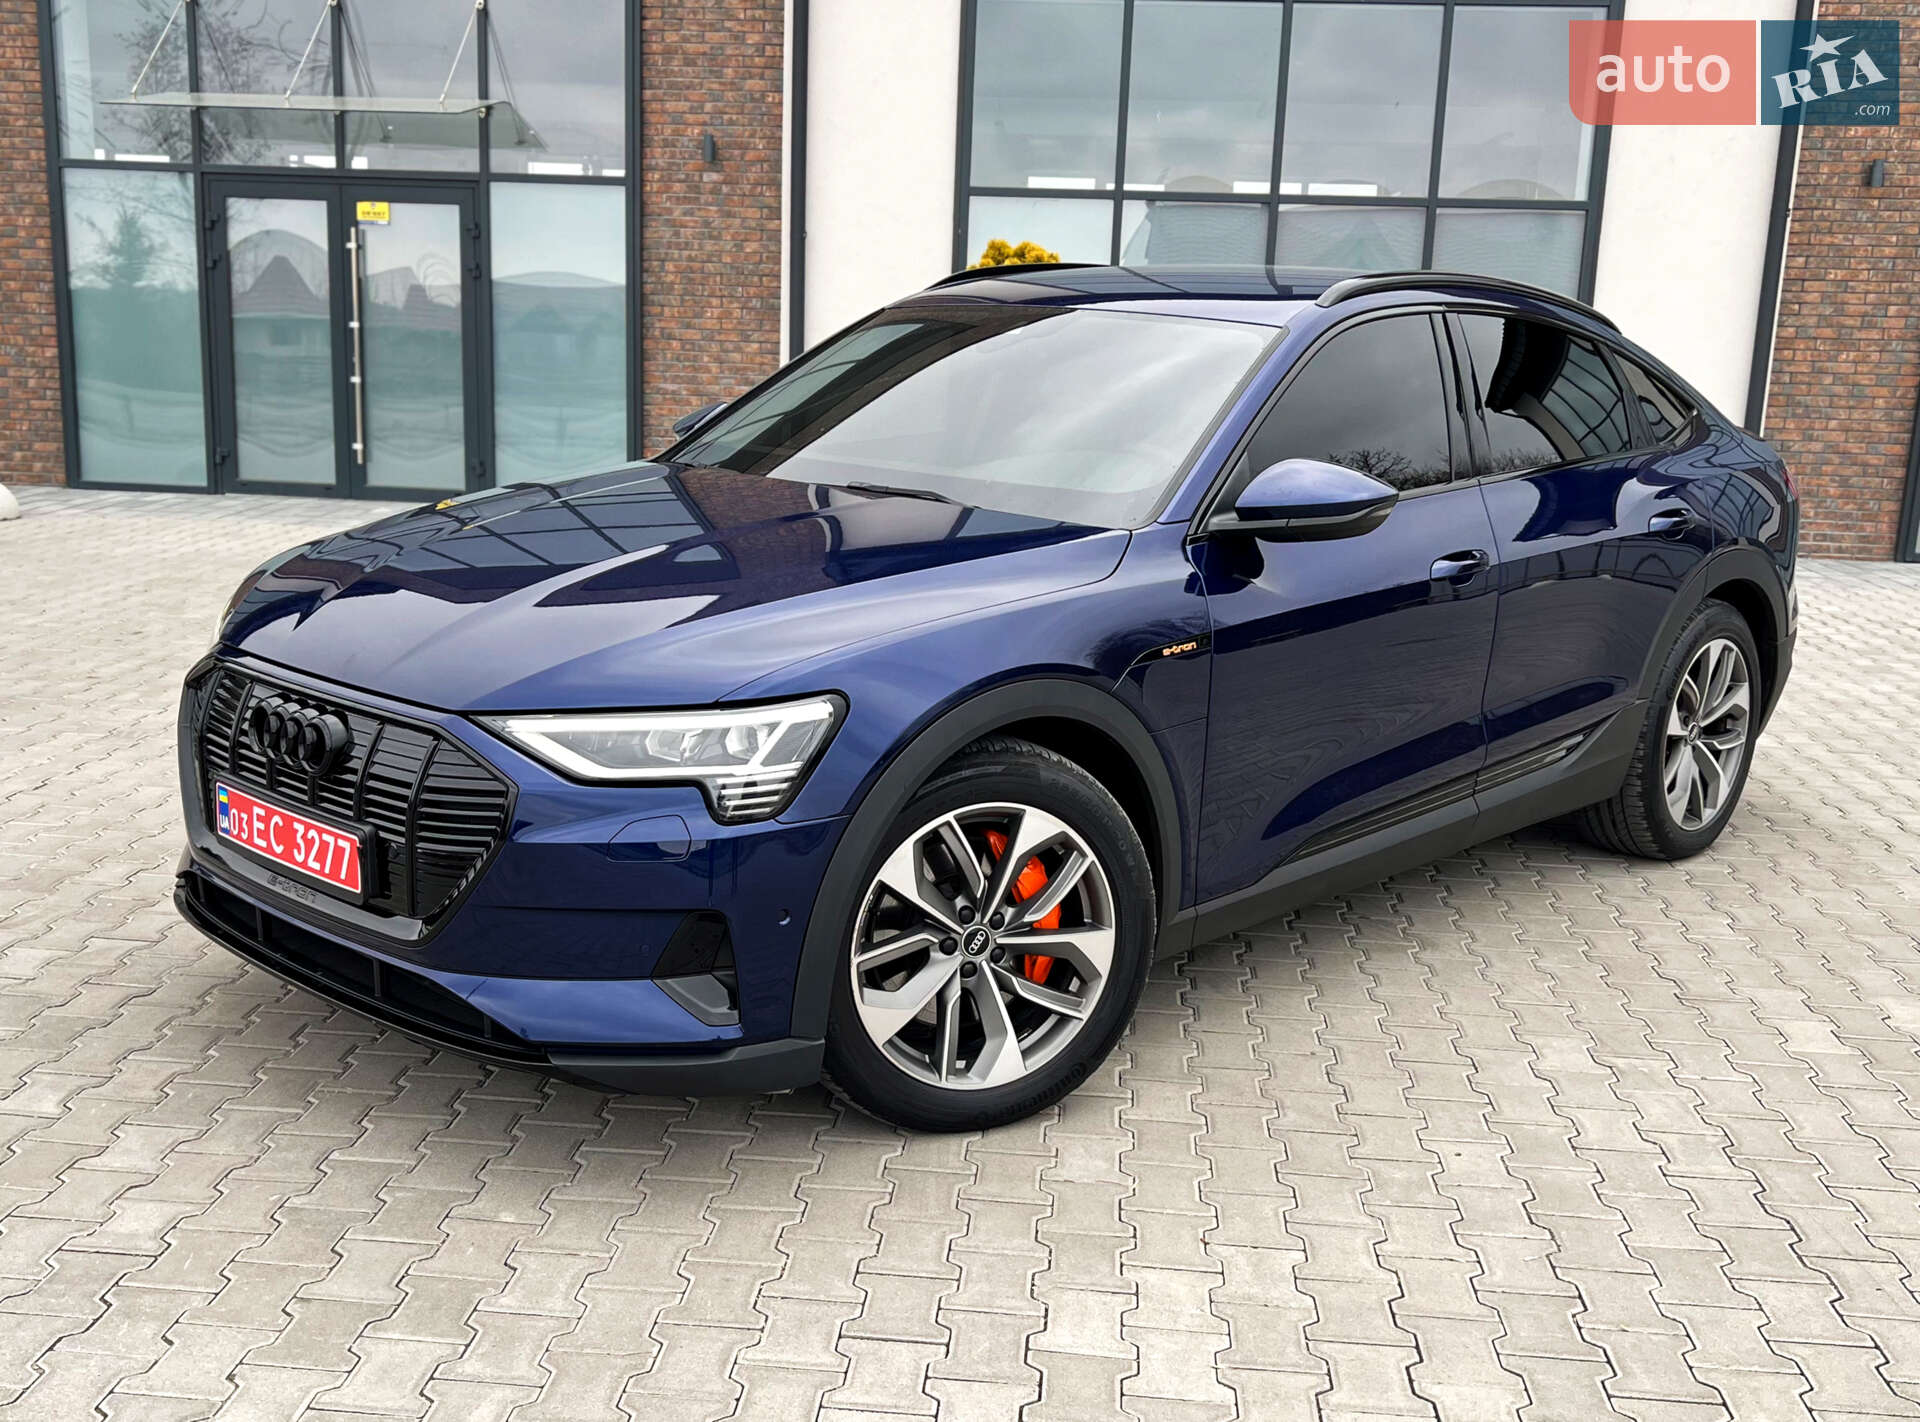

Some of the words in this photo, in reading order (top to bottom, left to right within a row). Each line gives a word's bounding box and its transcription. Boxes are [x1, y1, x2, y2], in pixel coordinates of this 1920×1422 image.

[1162, 641, 1197, 656] e-tron
[219, 814, 230, 830] UA
[230, 808, 249, 840] 03
[252, 805, 285, 854] EC
[293, 821, 351, 880] 3277
